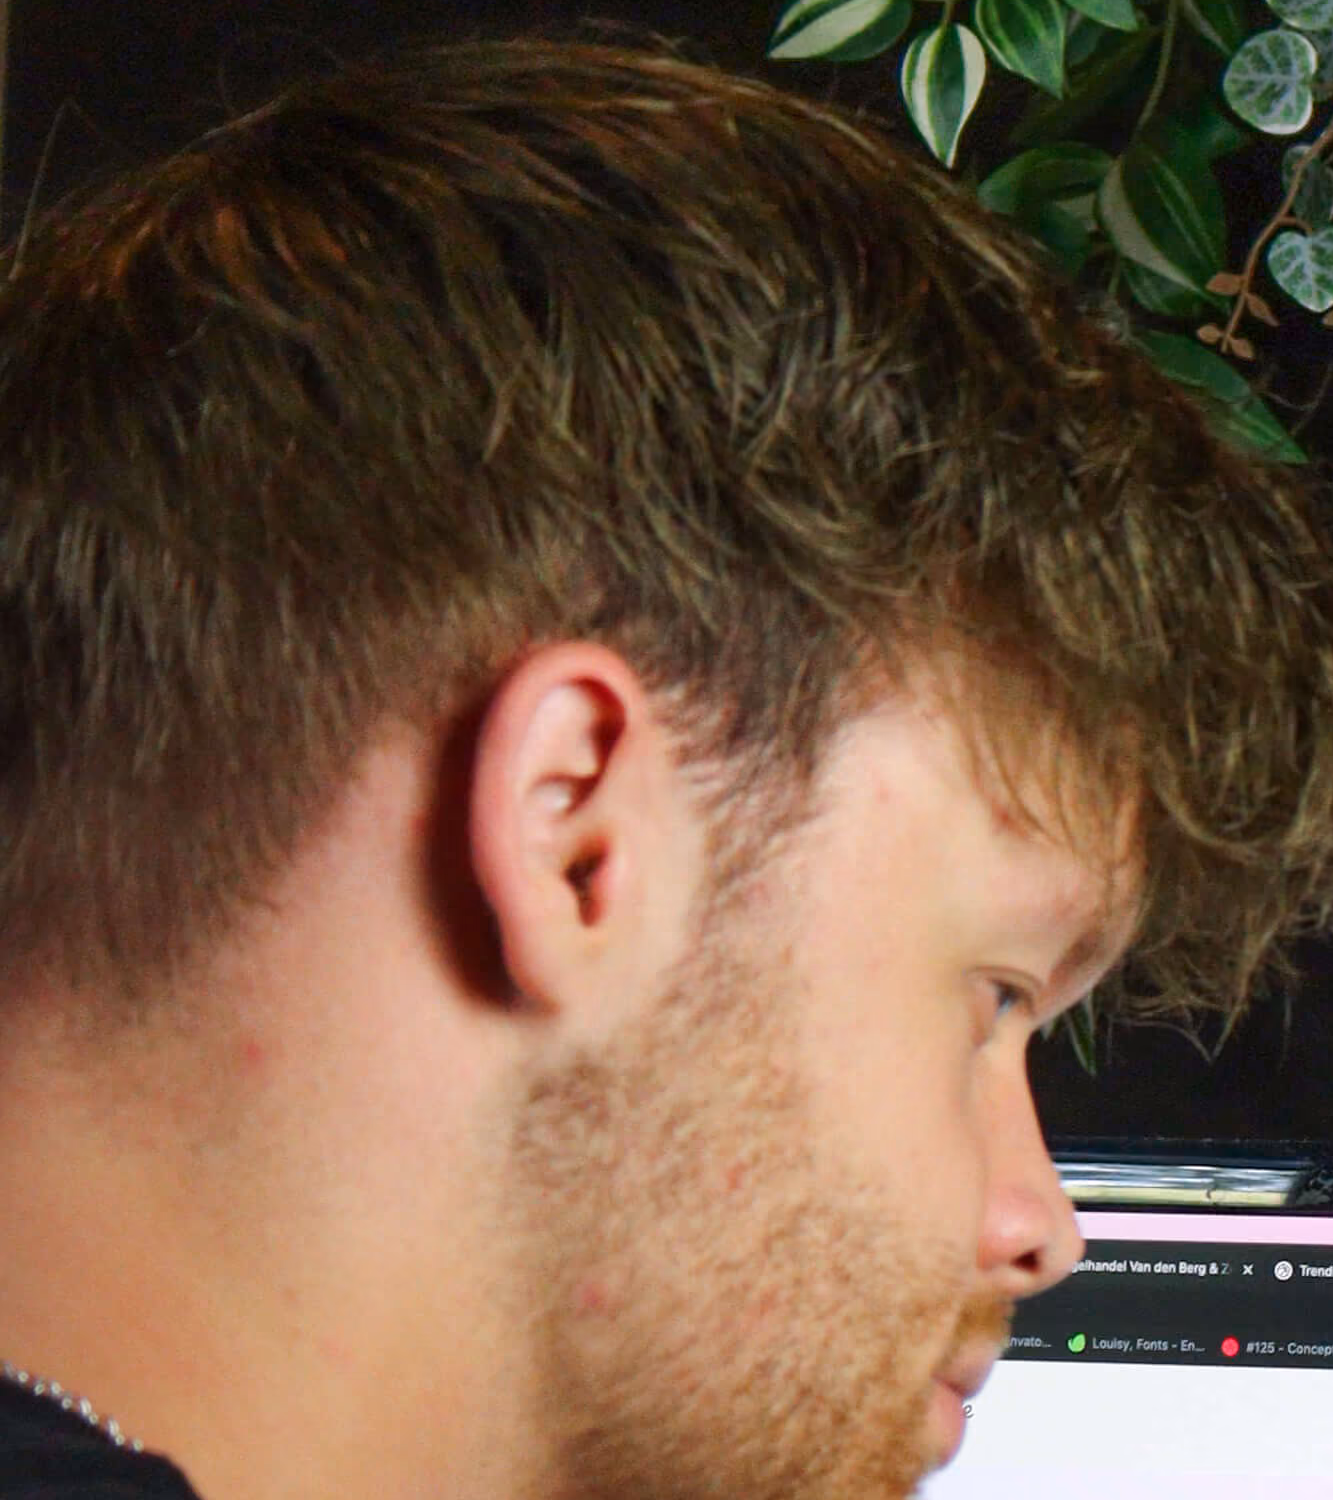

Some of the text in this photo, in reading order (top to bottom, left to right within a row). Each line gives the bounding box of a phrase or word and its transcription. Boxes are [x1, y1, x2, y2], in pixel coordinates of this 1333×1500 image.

[1130, 1260, 1151, 1274] Van
[1154, 1260, 1176, 1274] den
[1179, 1263, 1207, 1277] Berg
[1209, 1263, 1219, 1275] &
[1136, 1339, 1168, 1352] Fonts
